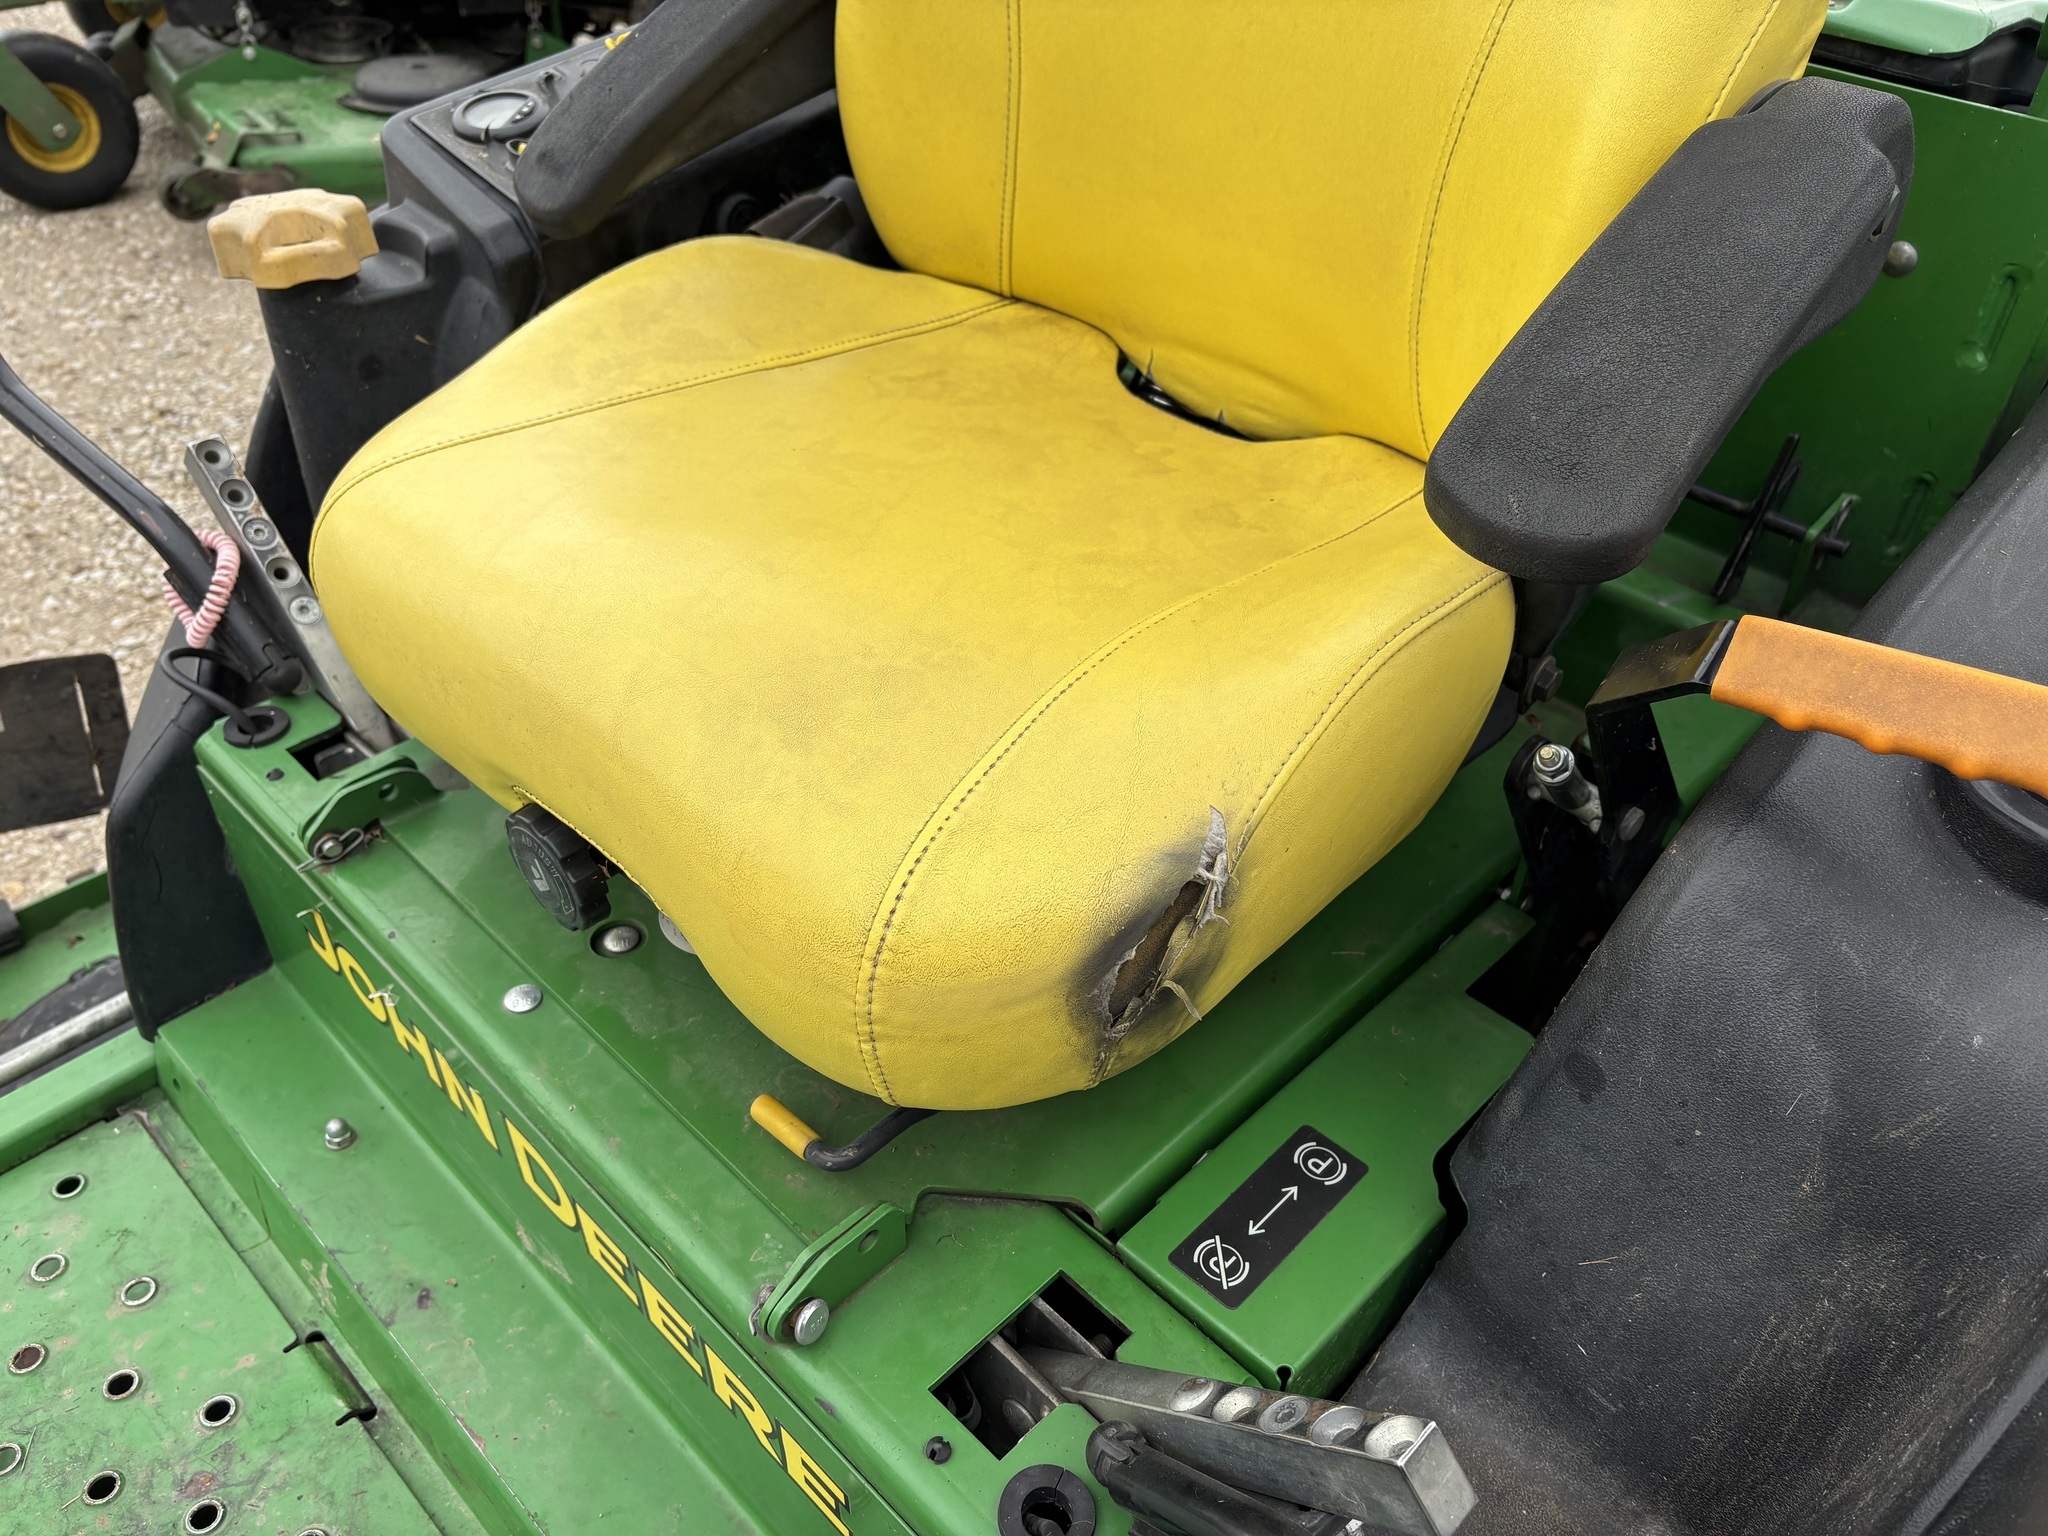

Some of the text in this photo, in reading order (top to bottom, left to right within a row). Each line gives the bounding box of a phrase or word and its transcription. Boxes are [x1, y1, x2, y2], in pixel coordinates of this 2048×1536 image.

[521, 834, 559, 876] ADJUST
[306, 908, 851, 1536] JOHN DEERE
